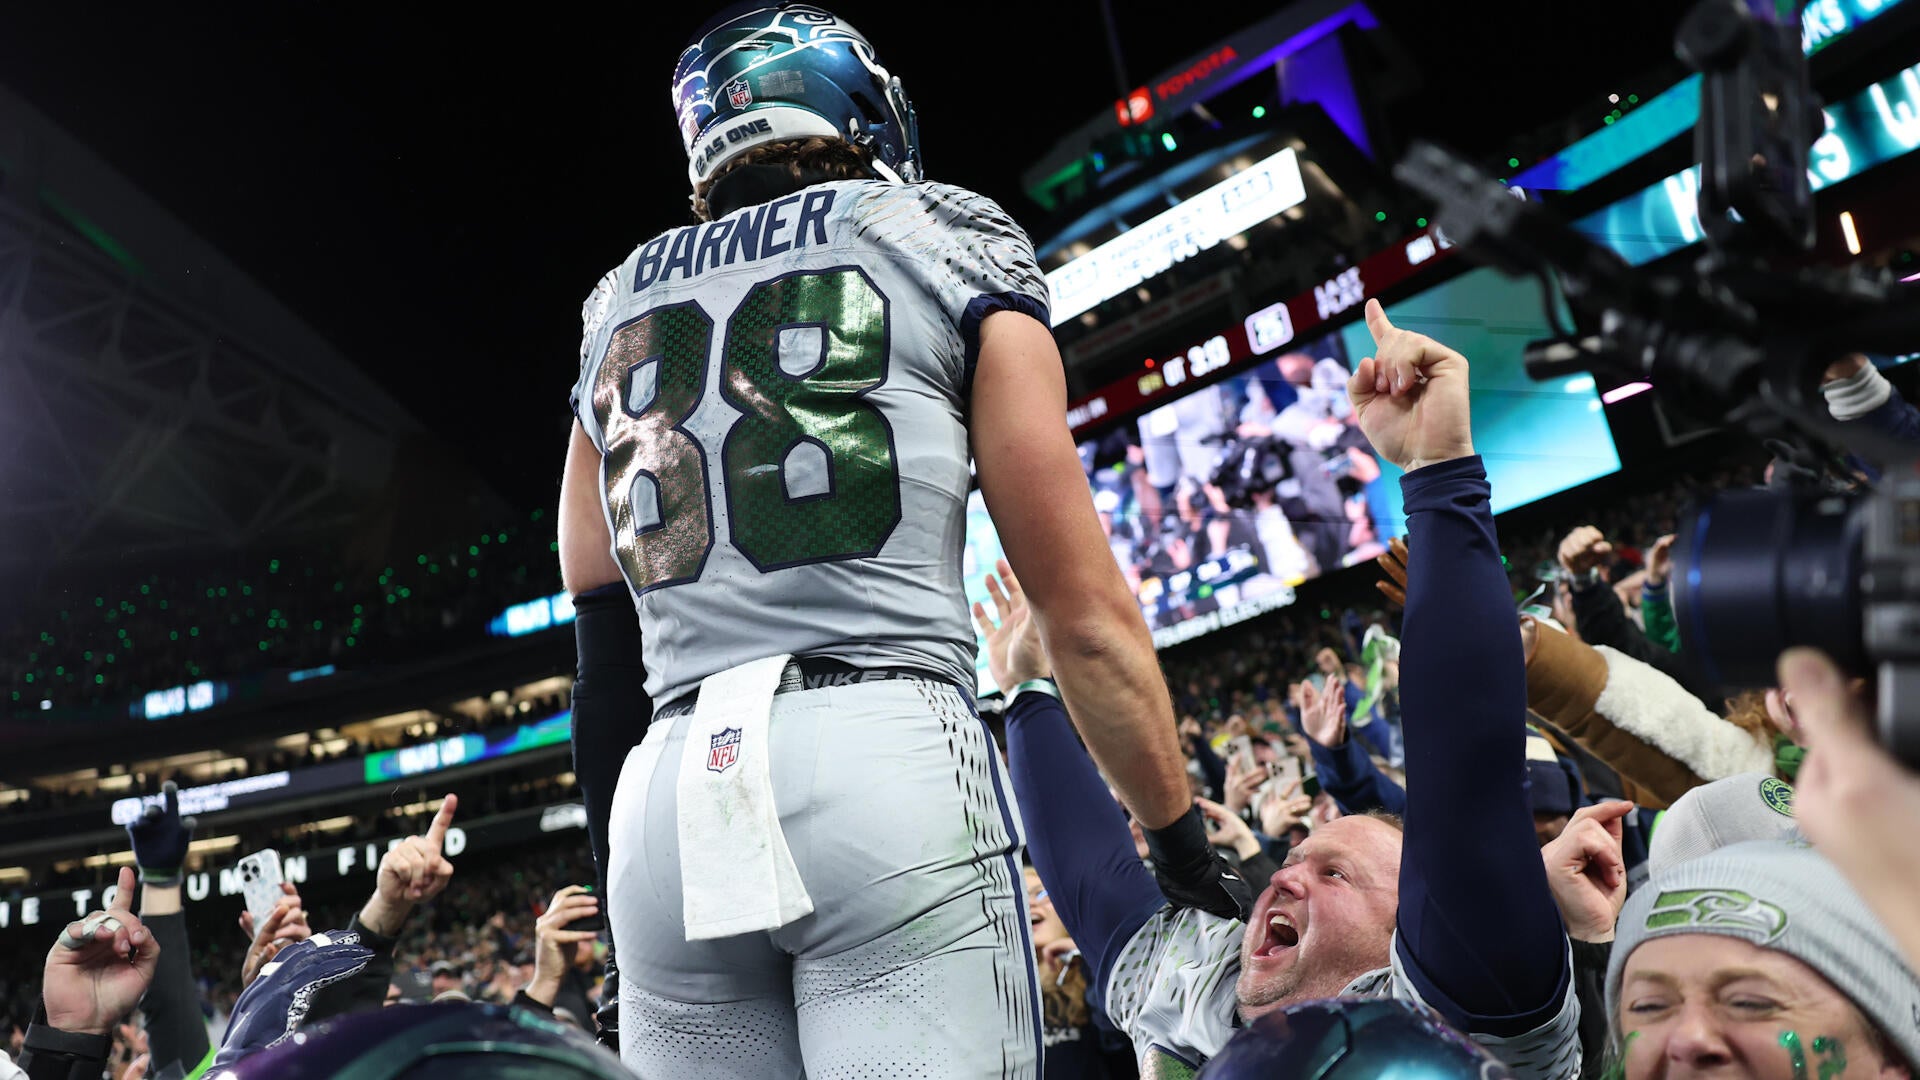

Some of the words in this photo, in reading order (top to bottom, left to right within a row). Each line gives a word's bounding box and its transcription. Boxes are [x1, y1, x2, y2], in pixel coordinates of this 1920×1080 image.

[732, 92, 749, 105] NFL
[1155, 45, 1237, 99] TOYOTA
[704, 136, 725, 162] AS
[726, 118, 772, 143] ONE
[633, 189, 837, 292] BARNER
[592, 265, 902, 597] 88
[711, 744, 735, 768] NFL
[187, 856, 307, 900] UMN
[338, 828, 467, 876] FID
